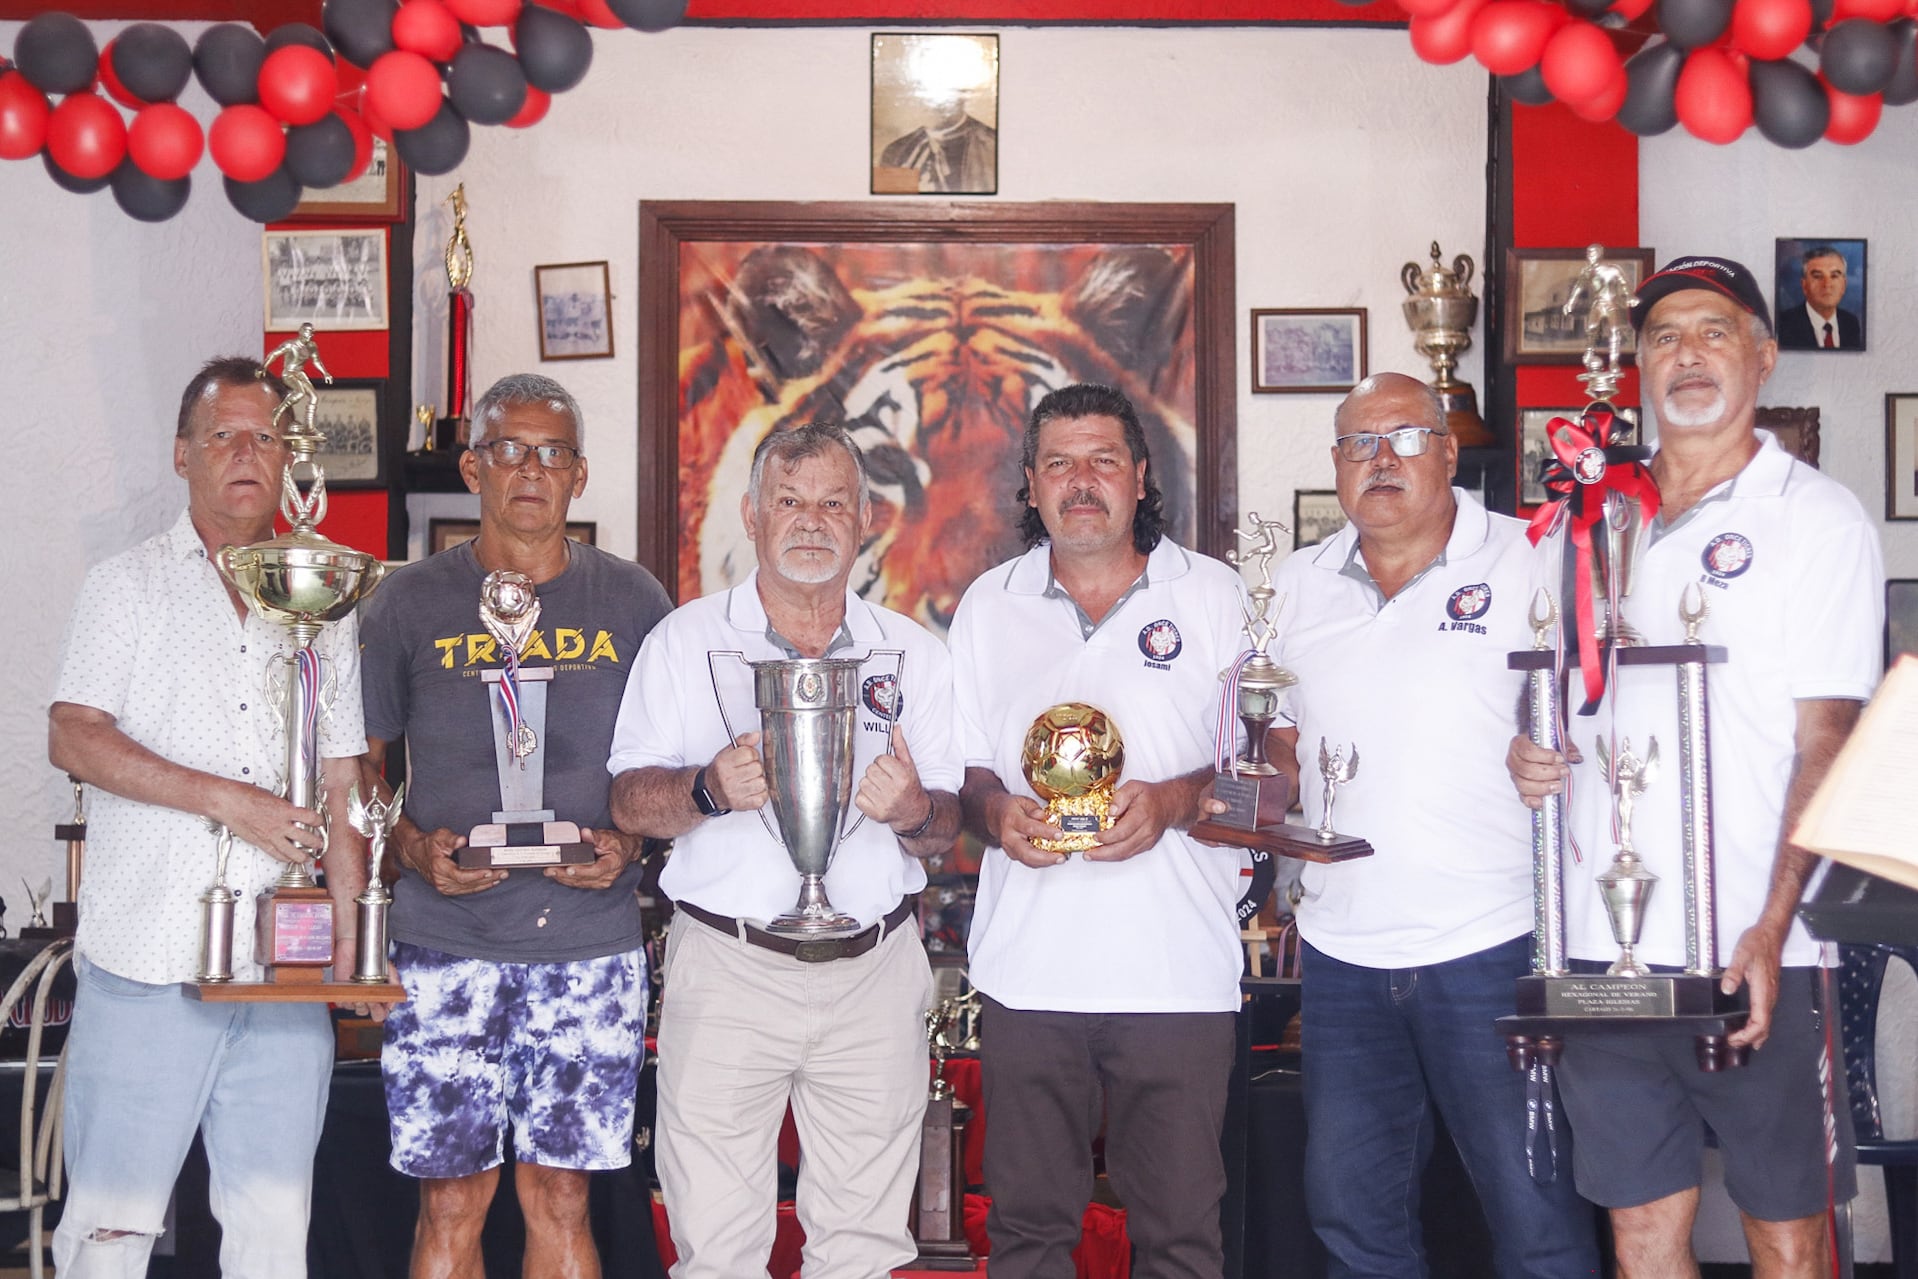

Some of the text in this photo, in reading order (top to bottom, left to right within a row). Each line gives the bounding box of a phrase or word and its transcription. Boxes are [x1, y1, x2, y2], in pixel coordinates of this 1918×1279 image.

[1693, 260, 1736, 278] DEPORTIVA
[1450, 621, 1487, 635] Vargas
[434, 627, 619, 670] TRADA
